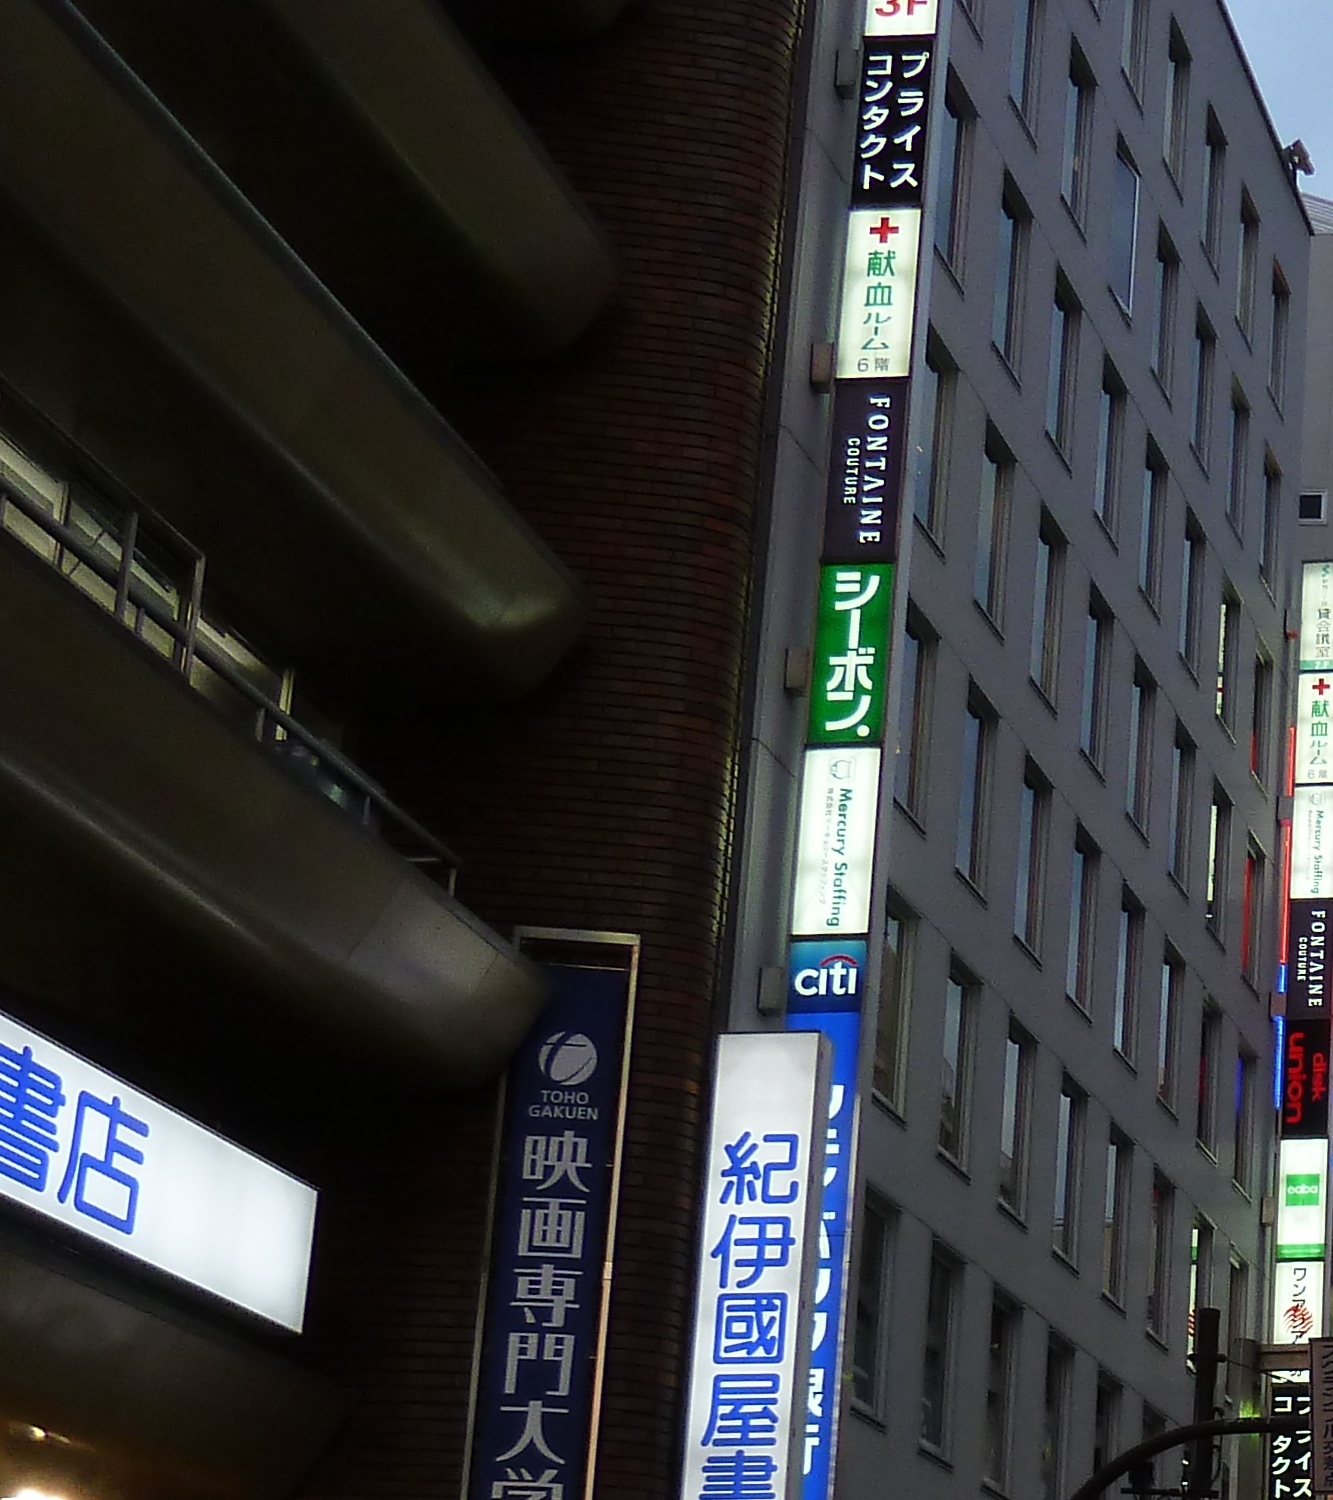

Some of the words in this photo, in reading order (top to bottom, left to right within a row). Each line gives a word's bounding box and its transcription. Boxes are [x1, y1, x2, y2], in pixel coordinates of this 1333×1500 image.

[859, 54, 894, 190] コンタクト
[889, 52, 930, 189] プライス
[861, 250, 896, 351] 献血ルーム
[842, 437, 860, 505] COUTURE
[859, 397, 891, 544] FONTAINE
[825, 571, 881, 738] シーボン
[1315, 607, 1332, 659] 貸会議室
[1309, 699, 1331, 766] 献血ルーム
[831, 788, 853, 857] Mercury
[825, 862, 848, 928] Staffing
[794, 960, 858, 996] citi
[1296, 936, 1308, 983] COUTURE
[1307, 909, 1327, 1008] FONTAINE
[541, 1089, 590, 1105] TOHO
[1285, 1031, 1305, 1124] union
[1311, 1052, 1327, 1102] disk
[528, 1104, 599, 1121] GAKUEN
